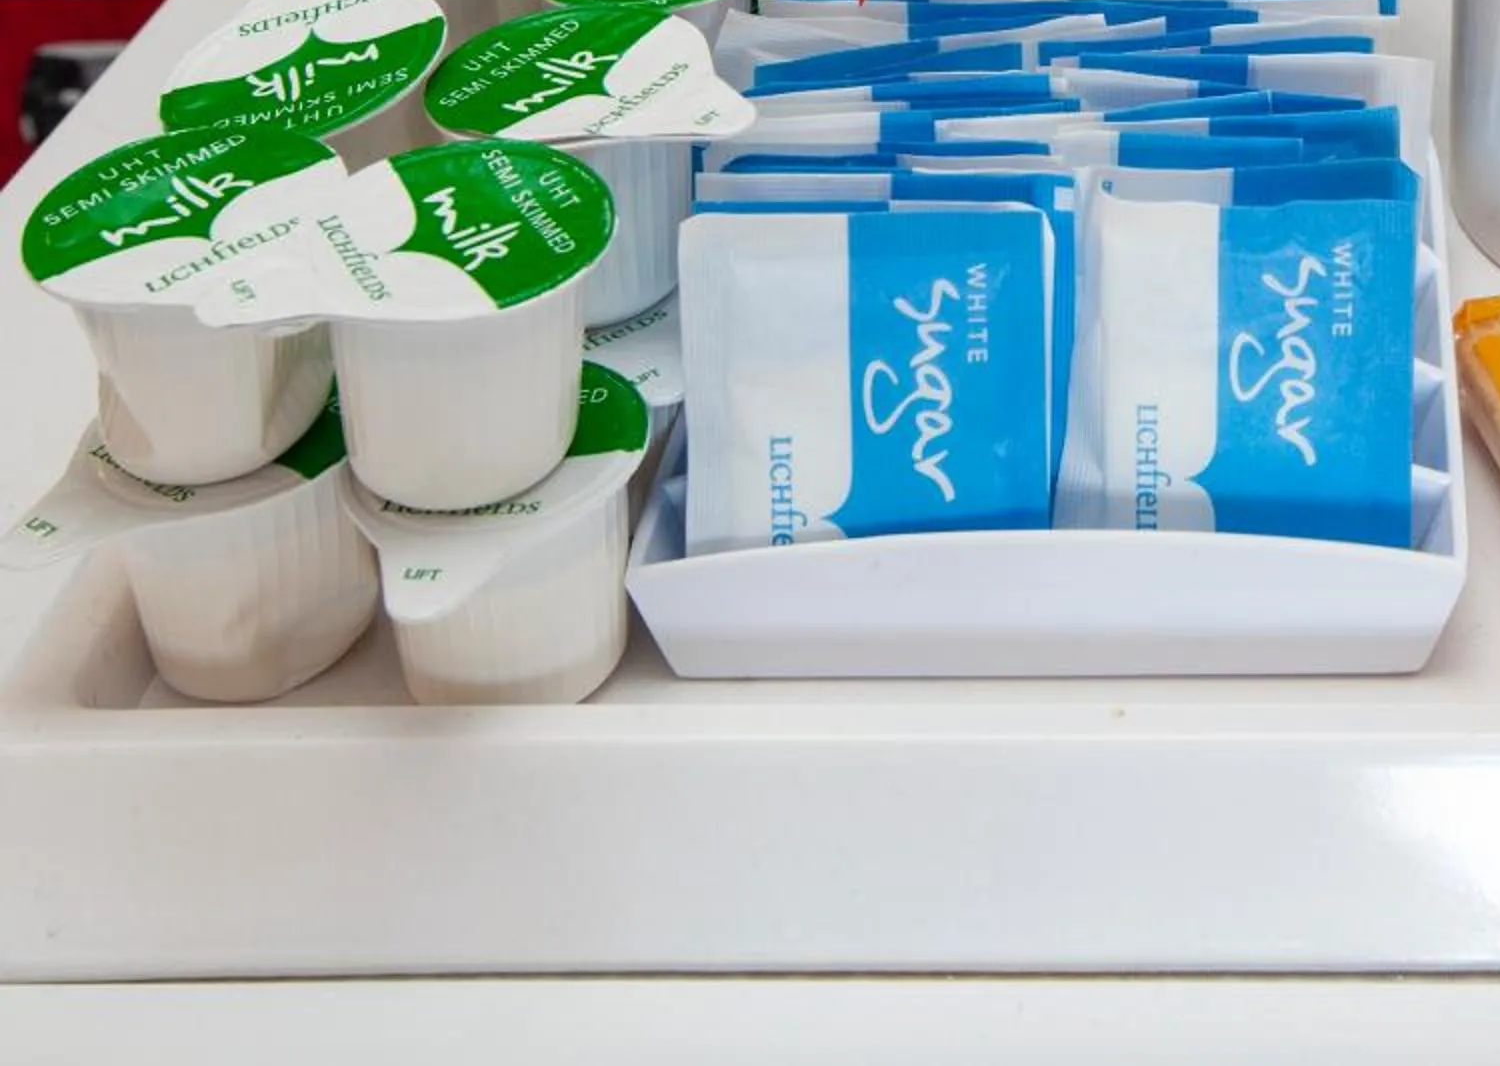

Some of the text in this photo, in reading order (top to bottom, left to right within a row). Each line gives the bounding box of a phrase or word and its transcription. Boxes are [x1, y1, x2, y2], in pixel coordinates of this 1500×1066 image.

[244, 42, 380, 103] milk
[347, 66, 409, 97] SEMI
[438, 18, 581, 109] SEMI SKIMMED
[462, 41, 512, 73] UHT
[502, 50, 623, 114] milk
[284, 104, 344, 130] UHT
[43, 133, 248, 227] SEMI SKIMMED
[98, 147, 162, 182] UHT
[538, 168, 582, 209] UHT
[98, 172, 256, 248] milk
[422, 185, 522, 272] milk
[481, 148, 577, 255] SEMI SKIMMED
[965, 261, 990, 365] WHITE
[1332, 241, 1353, 339] WHITE
[403, 566, 442, 583] LIFT
